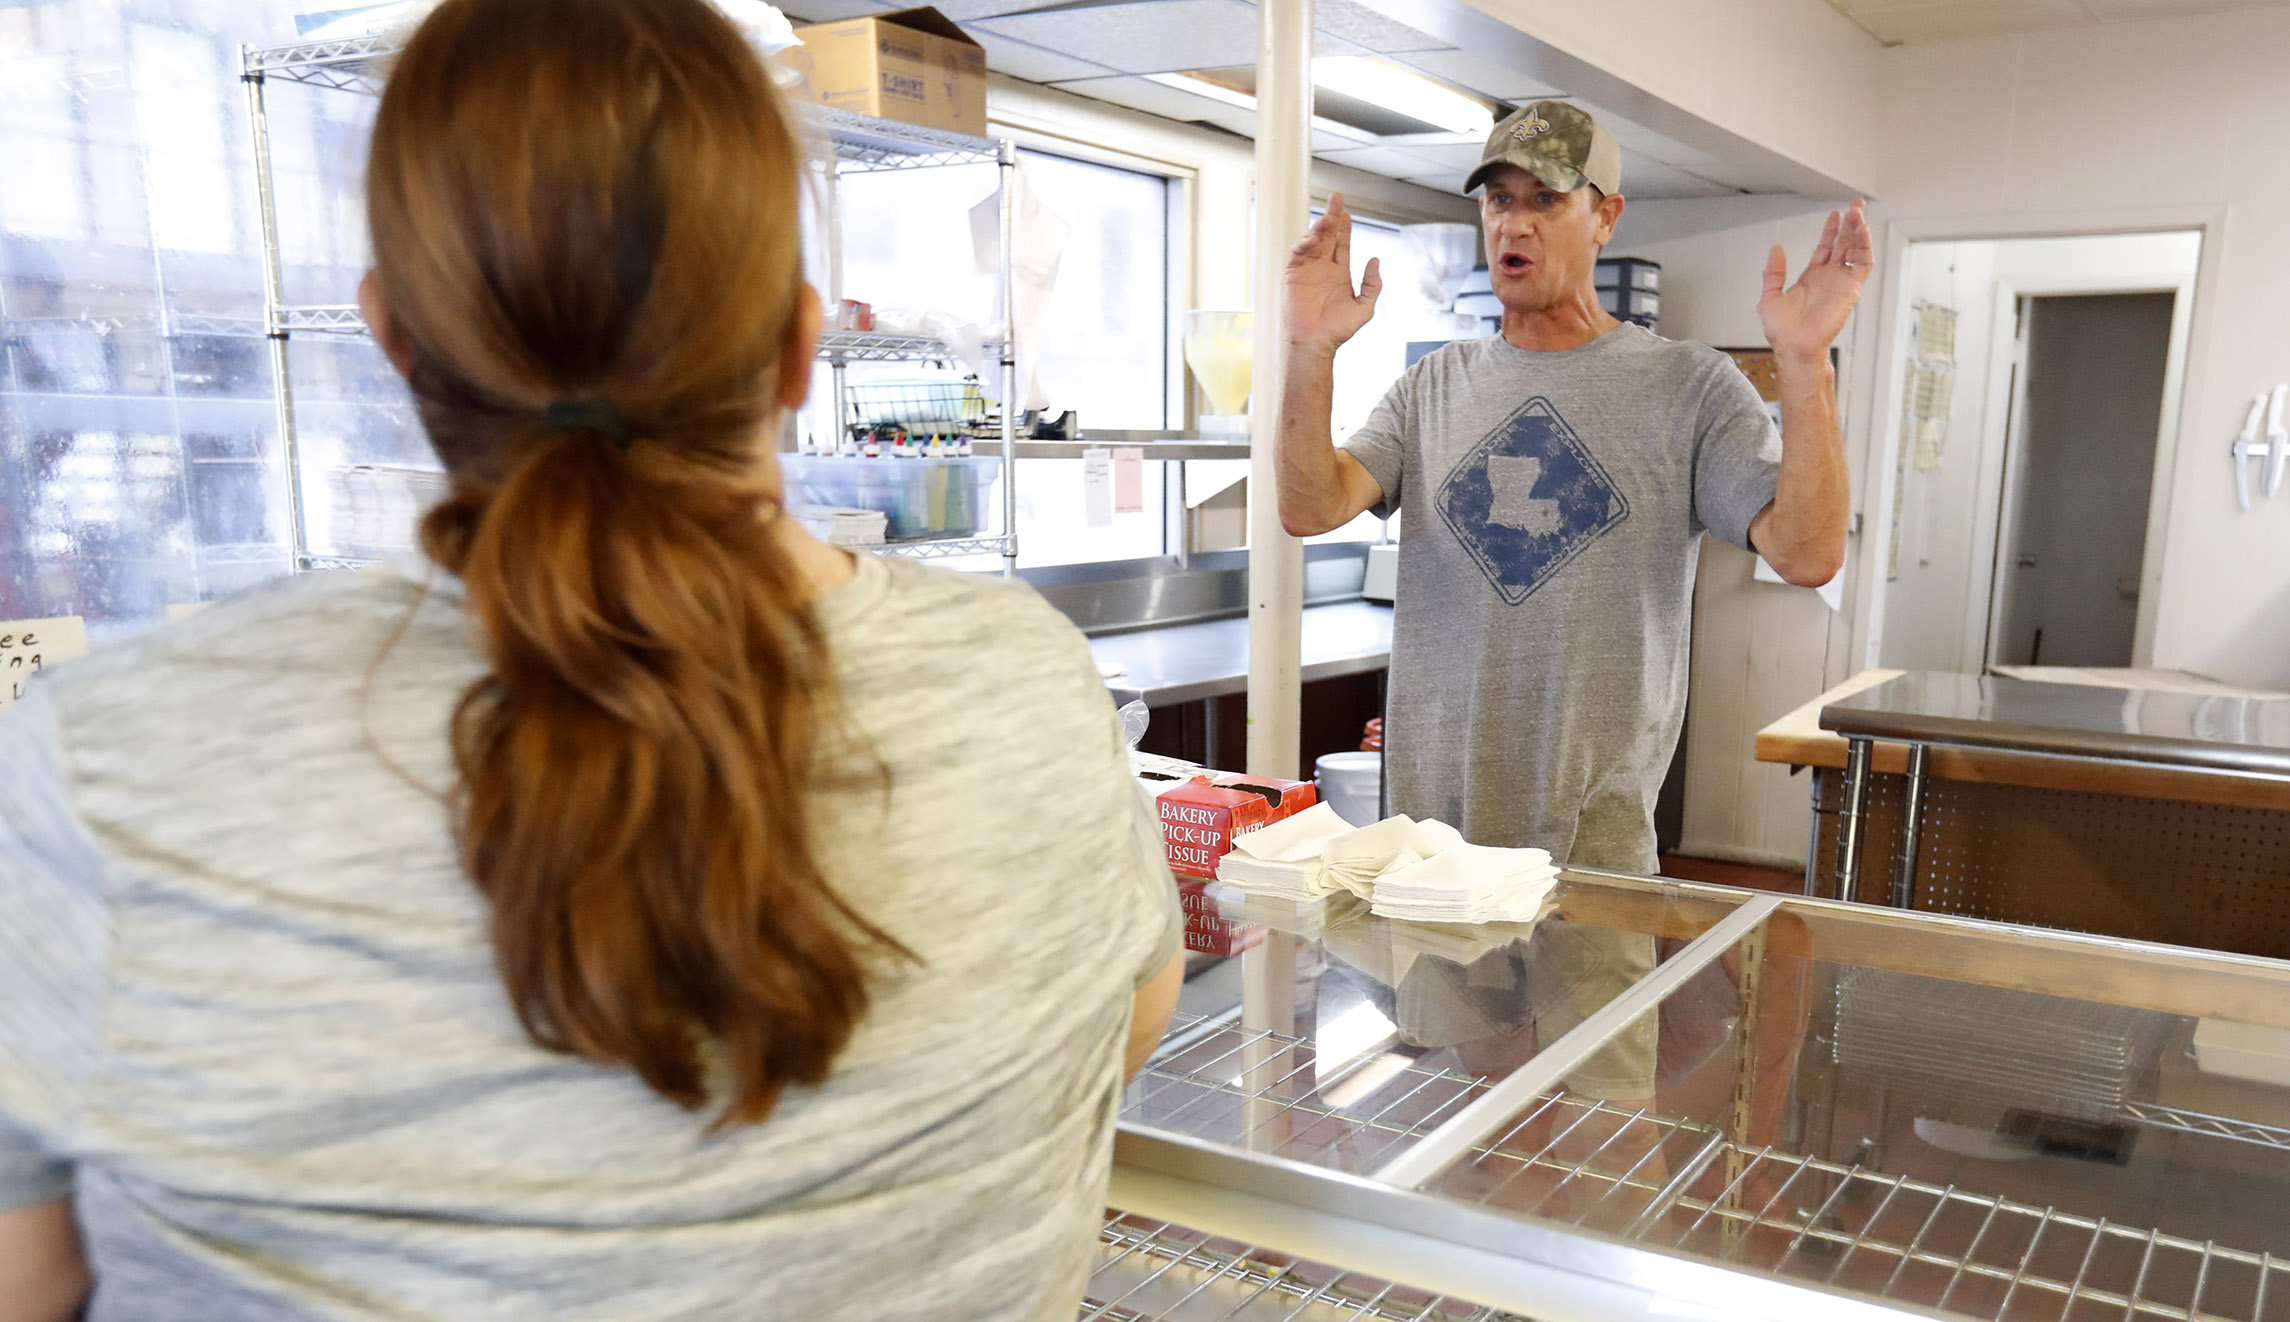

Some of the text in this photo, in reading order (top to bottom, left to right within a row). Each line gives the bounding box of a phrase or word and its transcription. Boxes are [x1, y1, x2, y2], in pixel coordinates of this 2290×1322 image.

[1550, 422, 1605, 489] EXPLORE
[1160, 801, 1218, 827] BAKERY
[1160, 821, 1221, 847] PICK-UP
[1165, 841, 1209, 865] ISSUE
